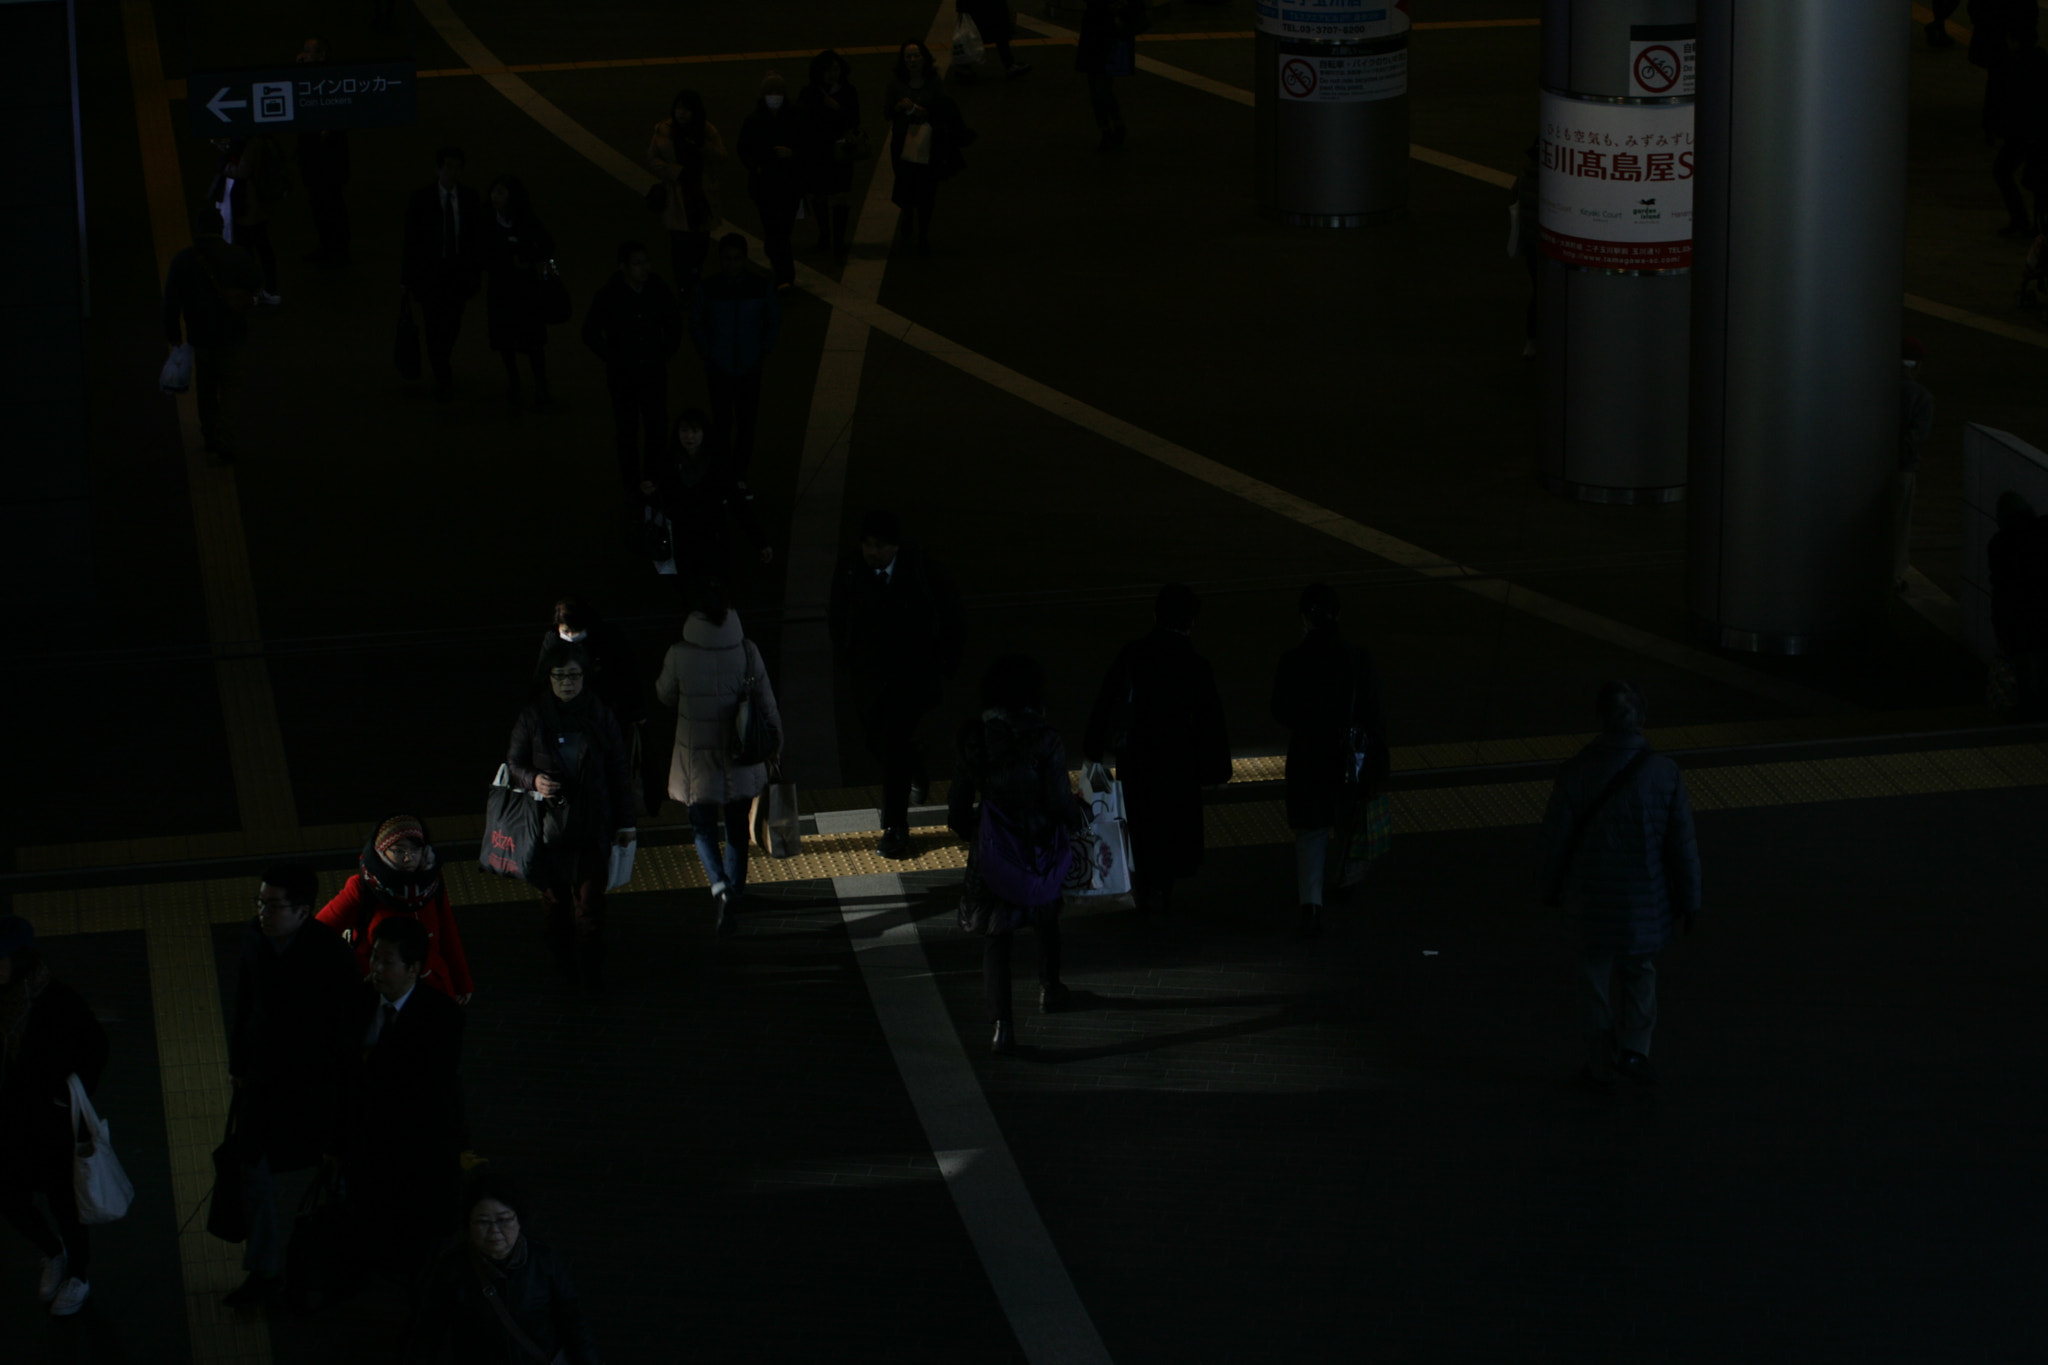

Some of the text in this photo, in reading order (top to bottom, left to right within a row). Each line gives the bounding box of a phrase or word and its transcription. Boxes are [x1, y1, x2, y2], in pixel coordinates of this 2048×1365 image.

[298, 76, 402, 96] コインロッカー
[299, 96, 352, 107] Coin Lockers
[1602, 209, 1622, 218] Court
[1633, 207, 1656, 215] garden
